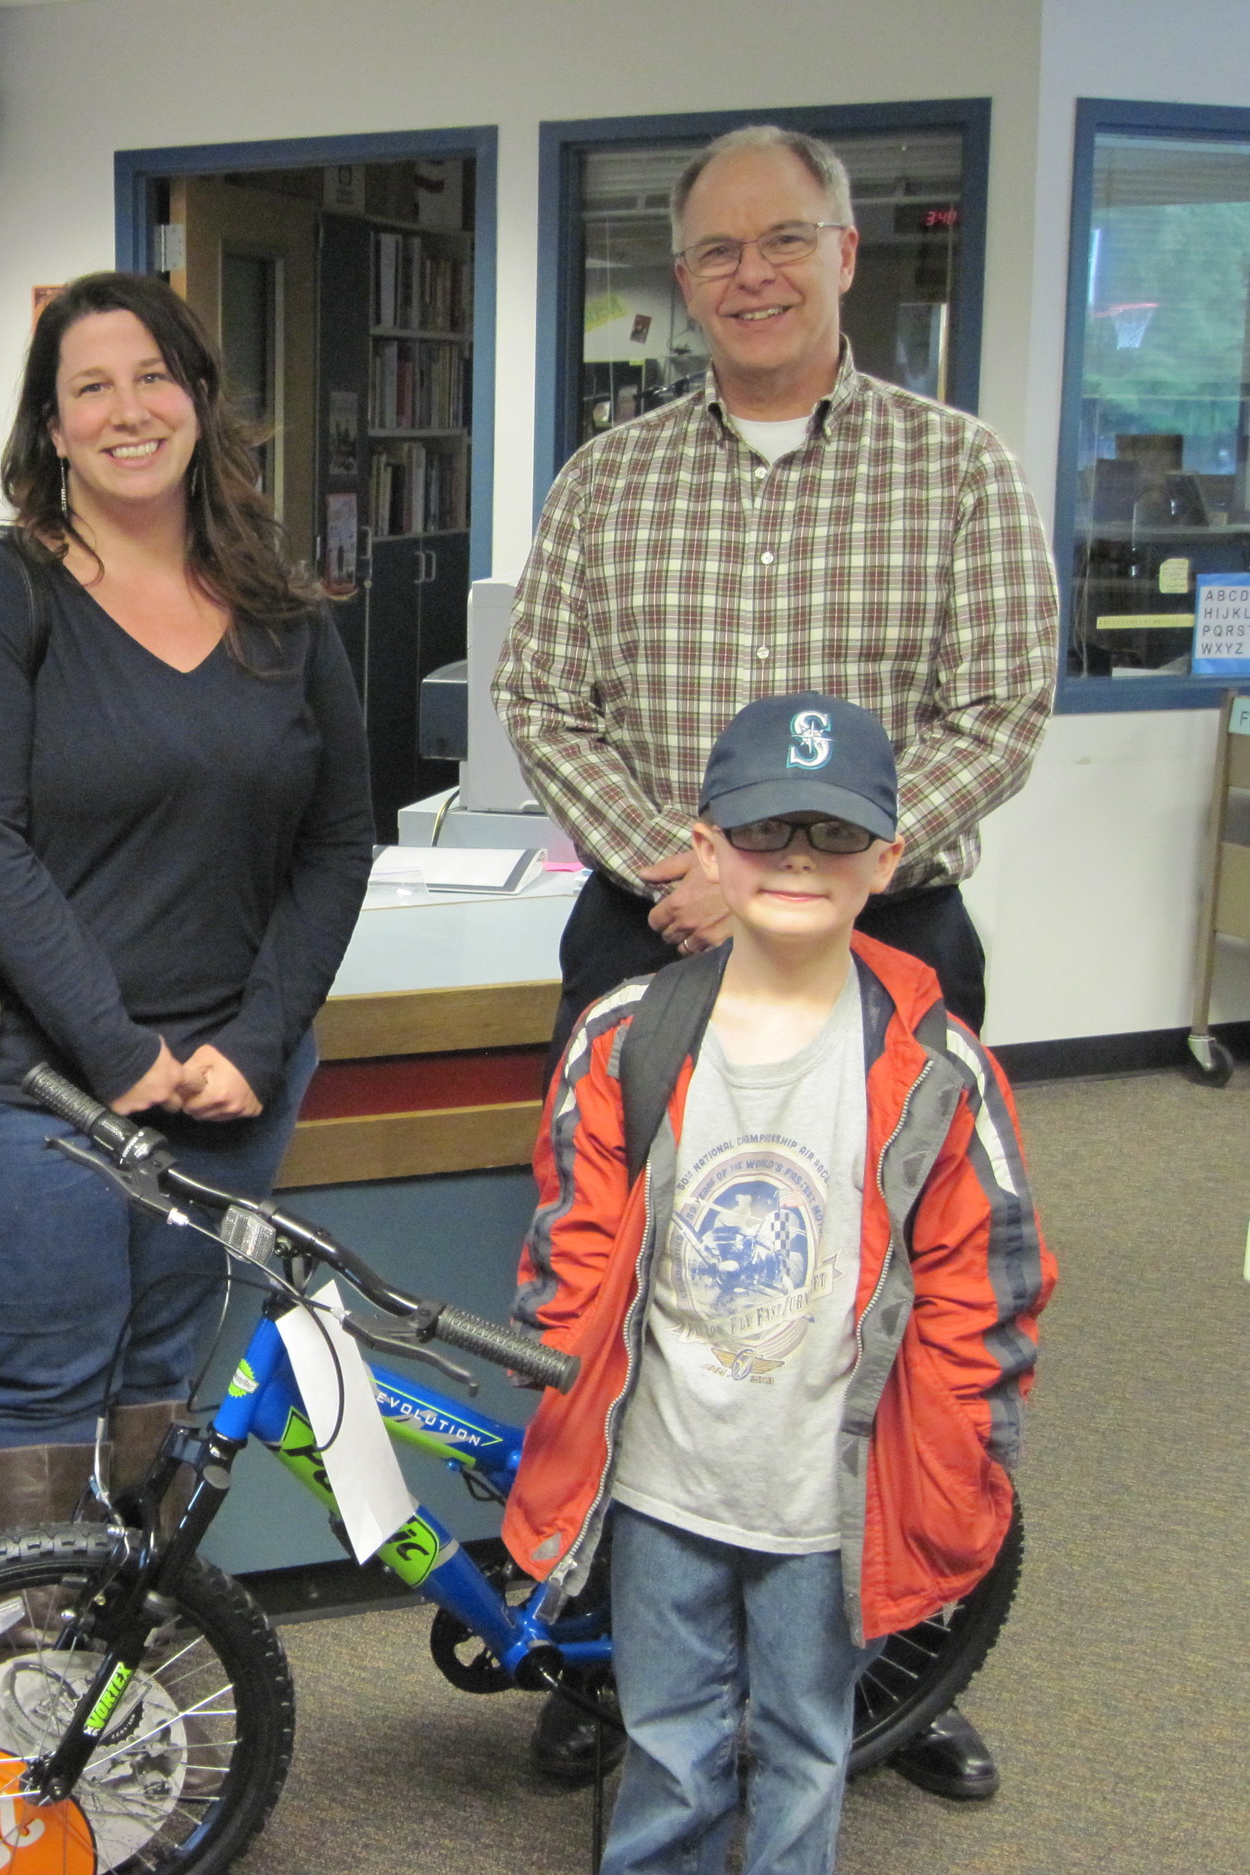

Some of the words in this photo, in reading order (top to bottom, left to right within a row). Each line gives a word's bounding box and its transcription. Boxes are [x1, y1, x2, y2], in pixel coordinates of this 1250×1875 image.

[693, 1140, 734, 1172] NATIONAL
[798, 1146, 817, 1162] AIR
[716, 1168, 729, 1182] OF
[784, 1167, 817, 1203] FASTEST
[376, 1391, 481, 1448] EVOLUTION
[86, 1661, 133, 1730] VORTEX
